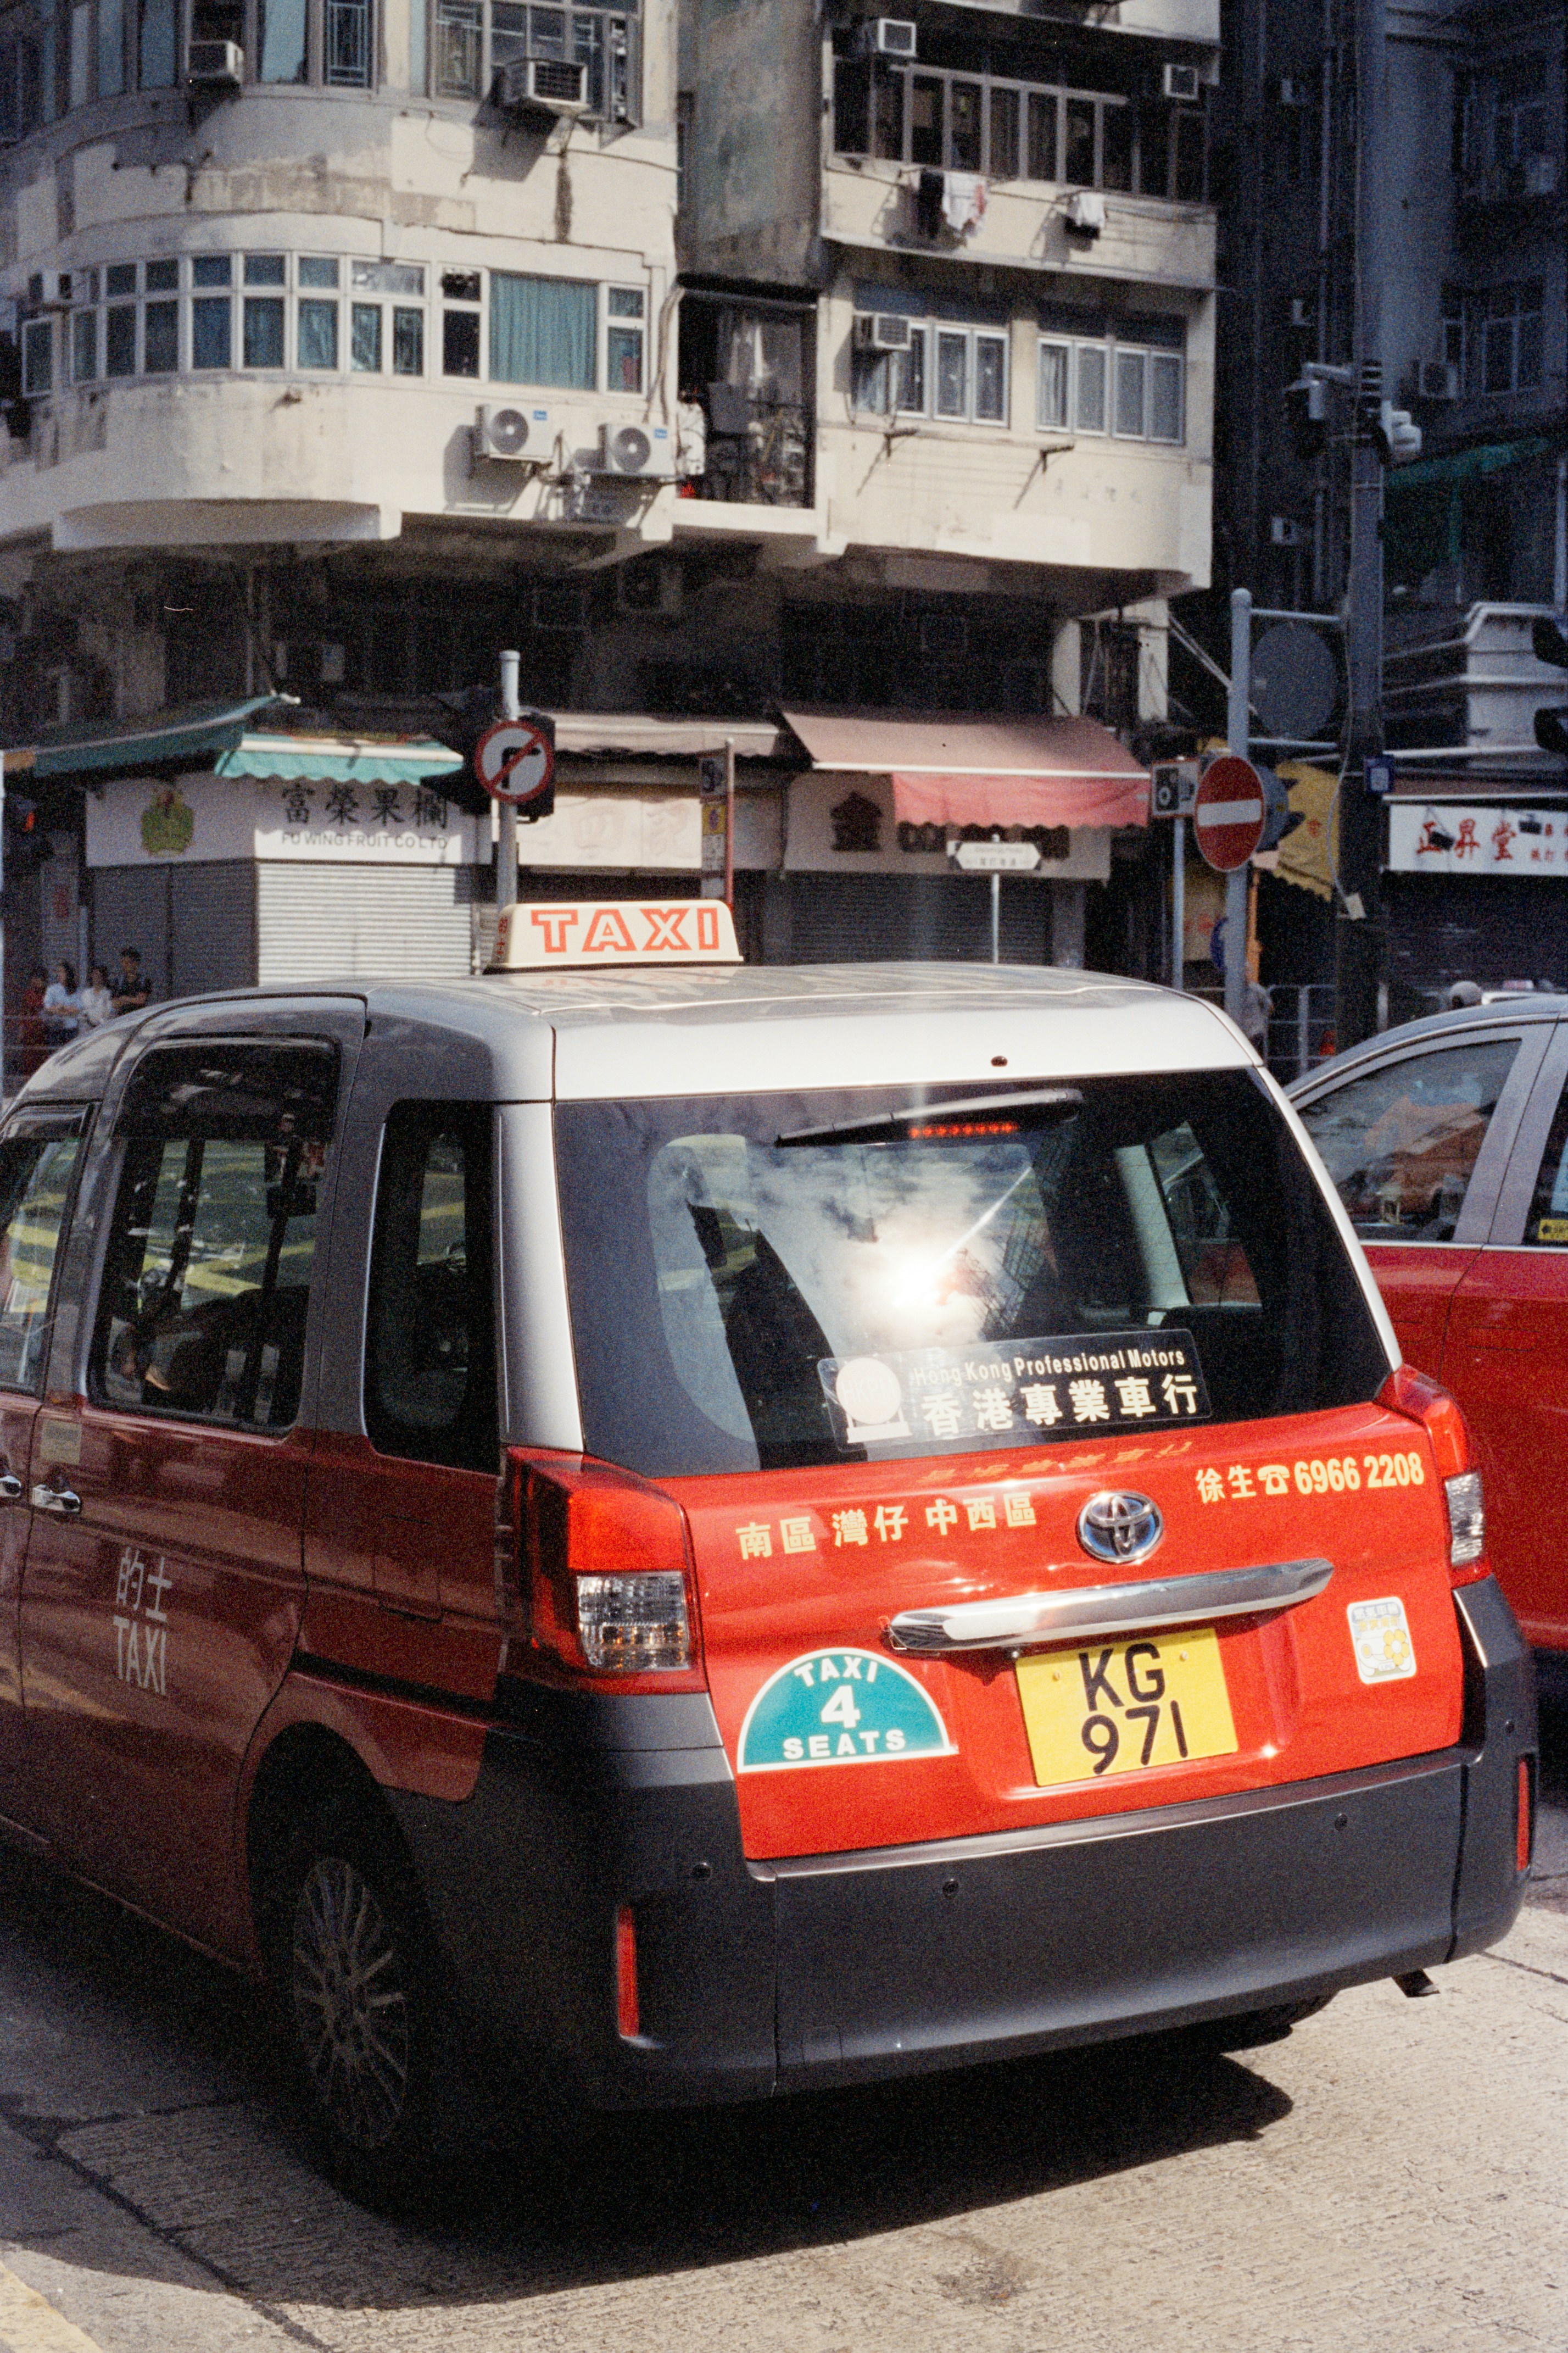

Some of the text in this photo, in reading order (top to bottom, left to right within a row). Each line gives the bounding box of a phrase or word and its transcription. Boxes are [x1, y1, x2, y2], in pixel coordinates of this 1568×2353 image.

[305, 832, 344, 847] WING
[346, 833, 390, 847] FRUIT
[394, 835, 415, 848] CO
[418, 835, 448, 849] LTD
[531, 908, 719, 954] TAXI
[914, 1348, 1185, 1388] Hong Kong Professional Motors
[921, 1373, 1197, 1437] 香港專業車行
[1196, 1451, 1425, 1504] 徐生 6966 2208
[735, 1491, 1037, 1560] 南區 灣仔 中西區
[116, 1547, 172, 1622] 的士
[113, 1615, 167, 1695] TAXI
[793, 1655, 878, 1688] TAXI
[1078, 1642, 1166, 1712] KG
[821, 1684, 861, 1729] 4
[783, 1728, 906, 1760] SEATS
[1081, 1699, 1189, 1776] 971
